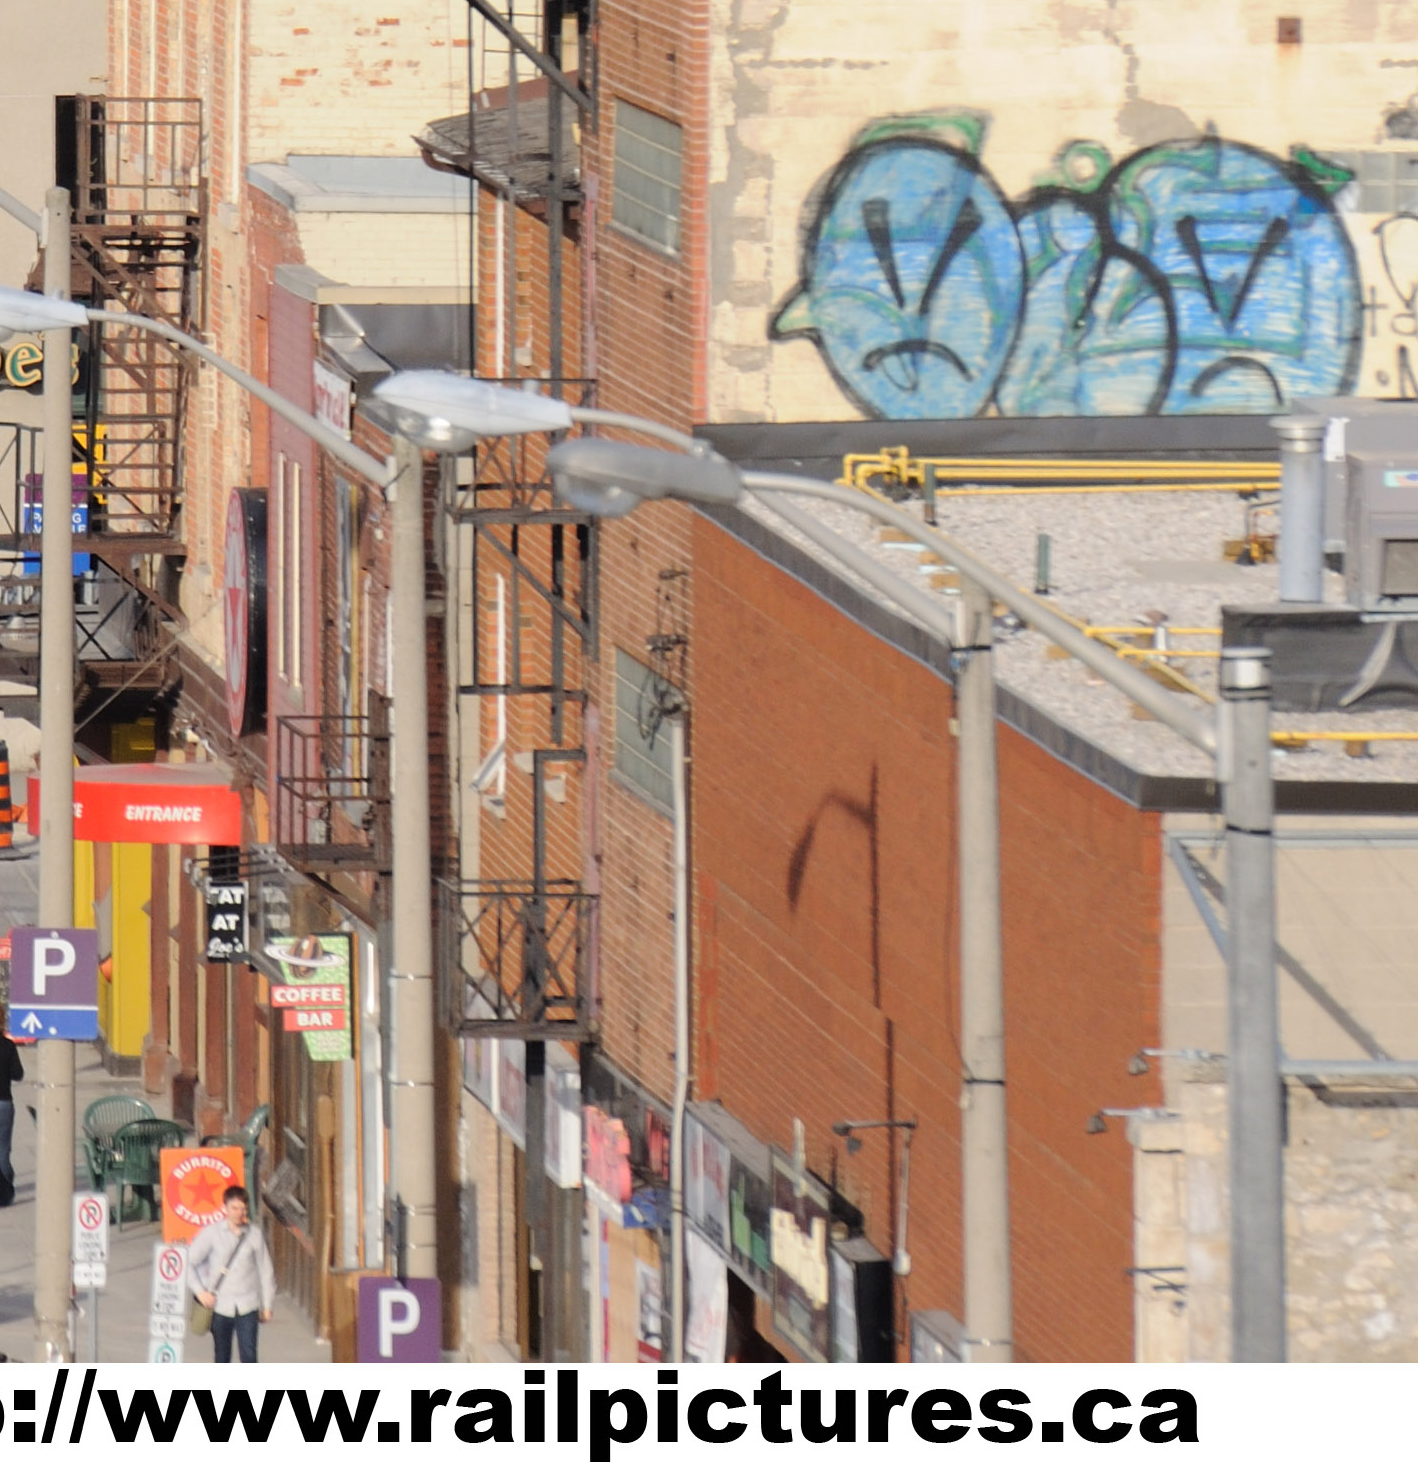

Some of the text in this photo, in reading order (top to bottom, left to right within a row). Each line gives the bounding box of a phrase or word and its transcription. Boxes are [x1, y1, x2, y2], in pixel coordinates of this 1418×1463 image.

[125, 805, 202, 822] ENTRANCE
[212, 914, 240, 930] AT
[33, 938, 76, 996] P
[274, 988, 342, 1003] COFFEE
[296, 1012, 333, 1026] BAR
[172, 1156, 232, 1180] BURRITO
[175, 1204, 229, 1226] STATIO
[378, 1288, 421, 1358] P
